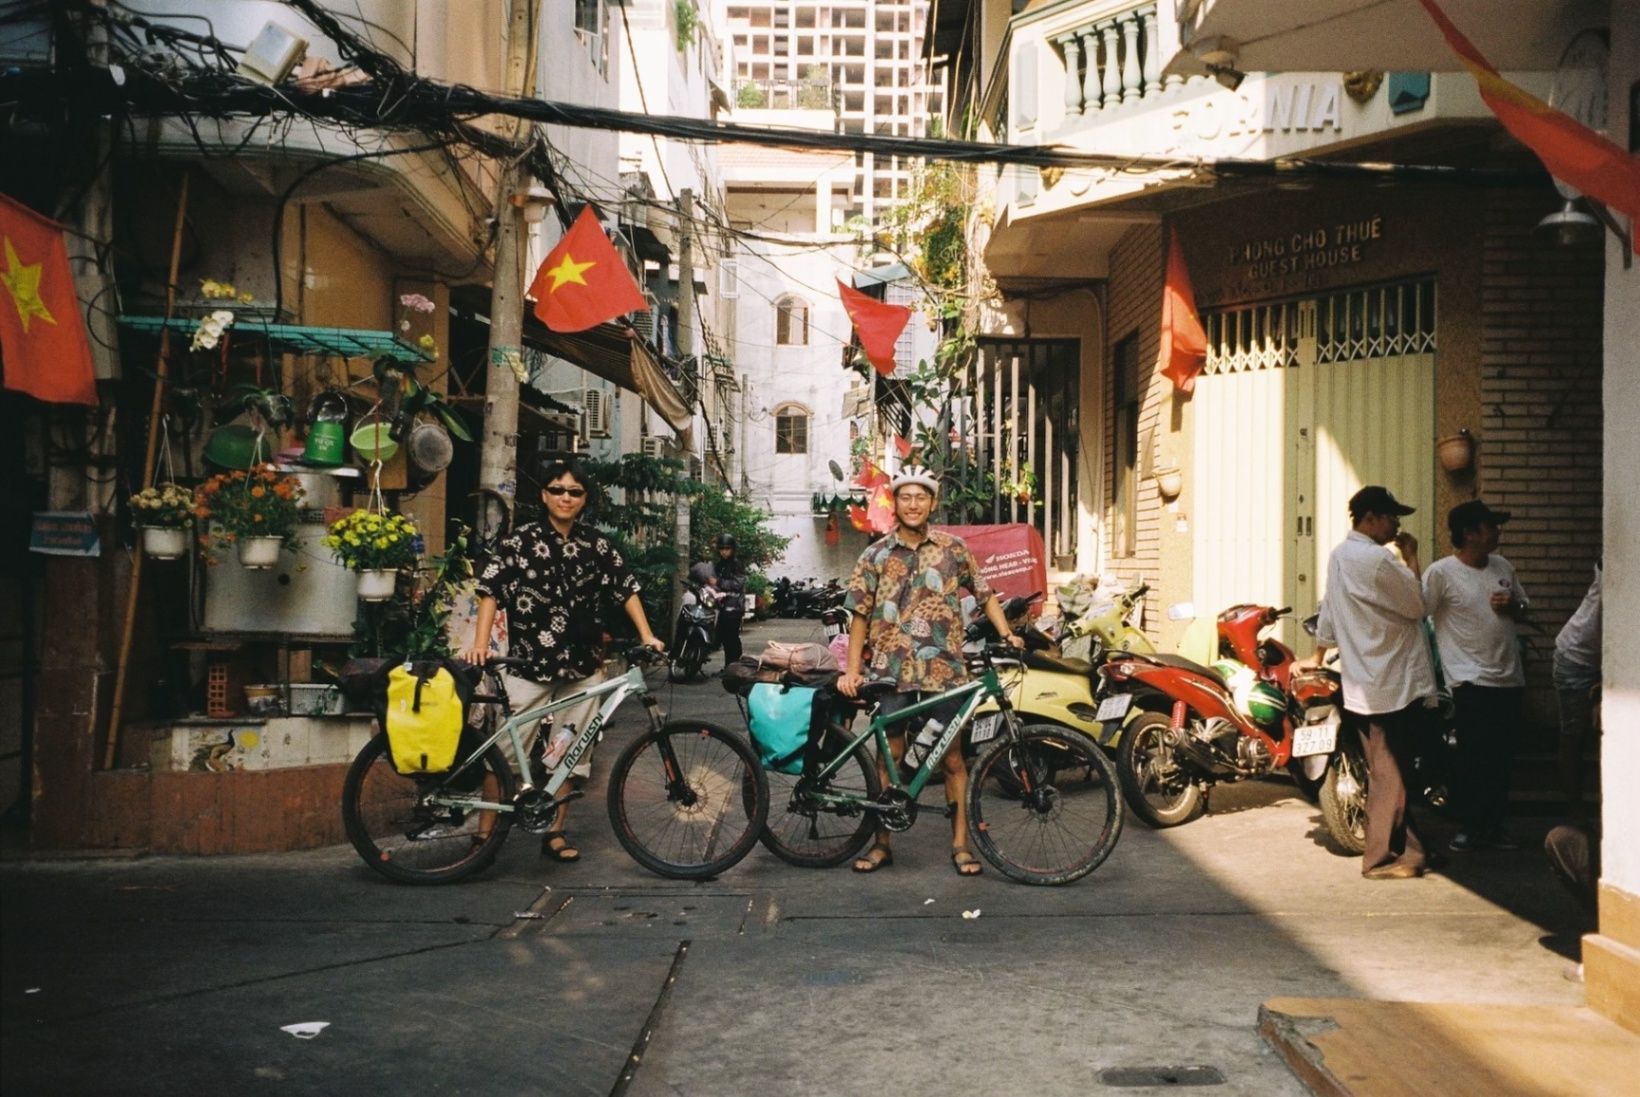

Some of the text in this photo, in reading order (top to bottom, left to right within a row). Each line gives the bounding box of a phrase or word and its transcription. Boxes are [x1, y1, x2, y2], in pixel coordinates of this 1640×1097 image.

[1291, 229, 1327, 253] CHO
[1248, 244, 1361, 279] GUEST HOUSE
[996, 550, 1029, 562] HONDA
